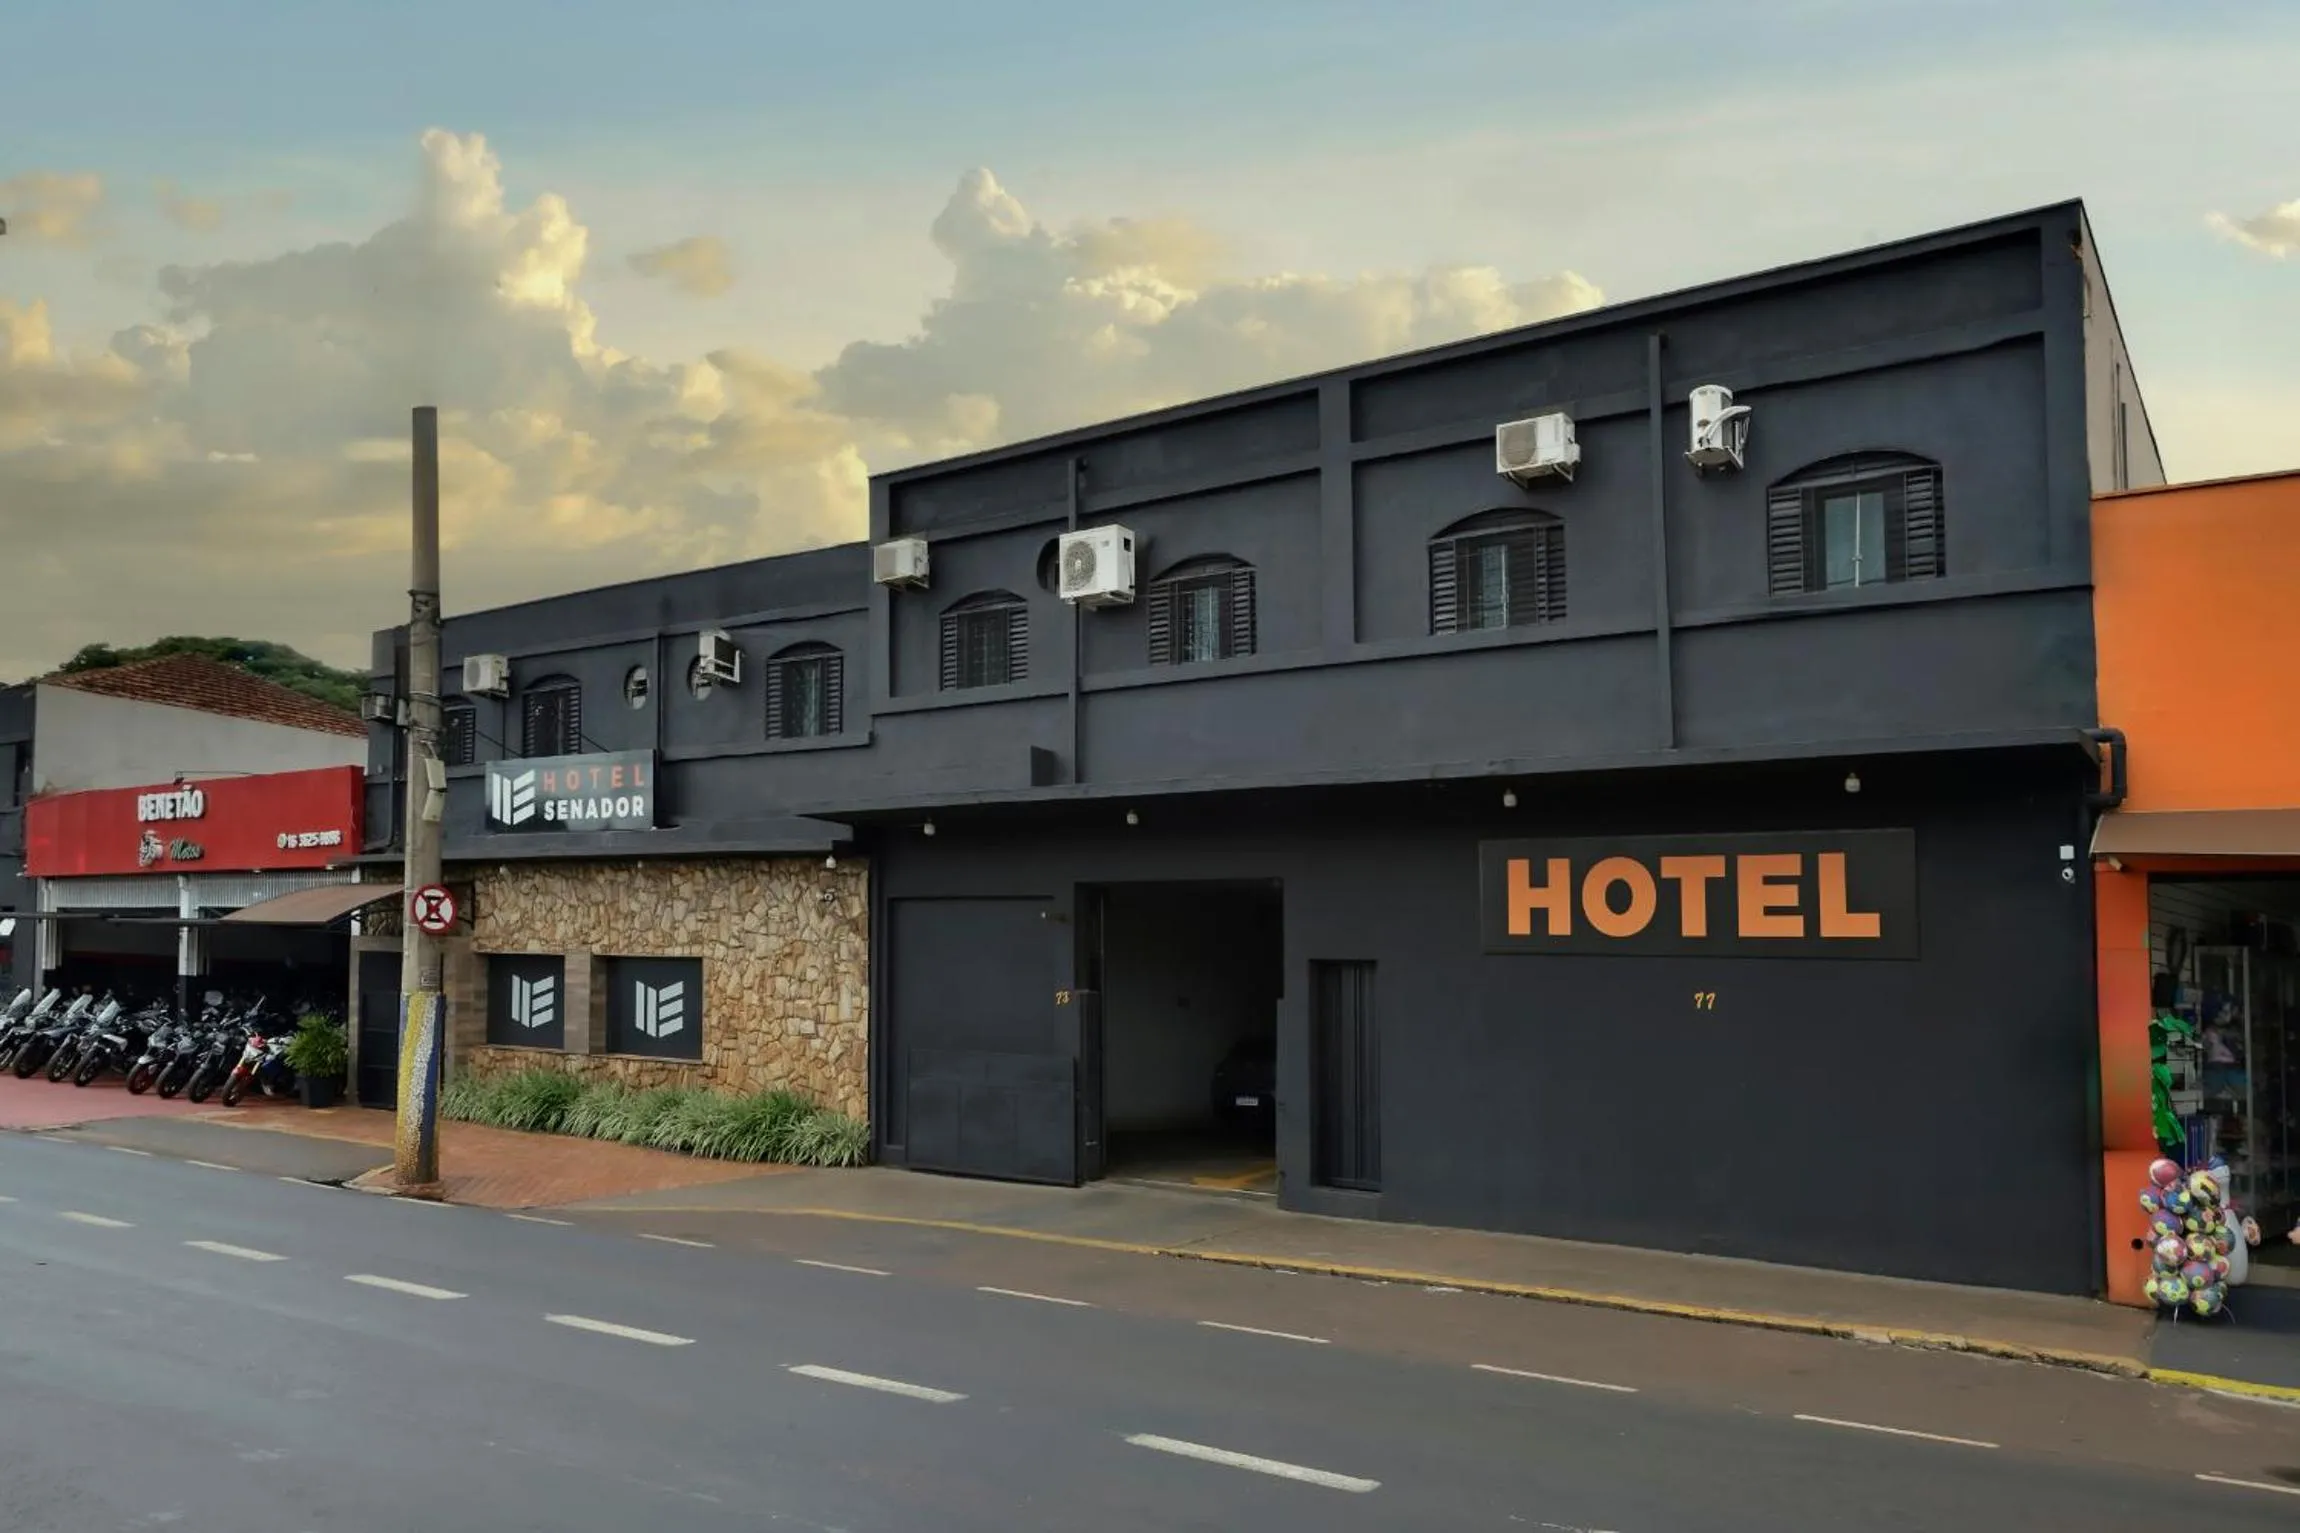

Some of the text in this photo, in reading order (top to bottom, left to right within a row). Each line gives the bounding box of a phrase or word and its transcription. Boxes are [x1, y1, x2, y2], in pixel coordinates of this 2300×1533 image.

[543, 763, 645, 792] HOTEL
[137, 784, 204, 822] BENETÃO
[543, 795, 645, 821] SENADOR
[1507, 852, 1881, 938] HOTEL
[1694, 991, 1716, 1010] 77
